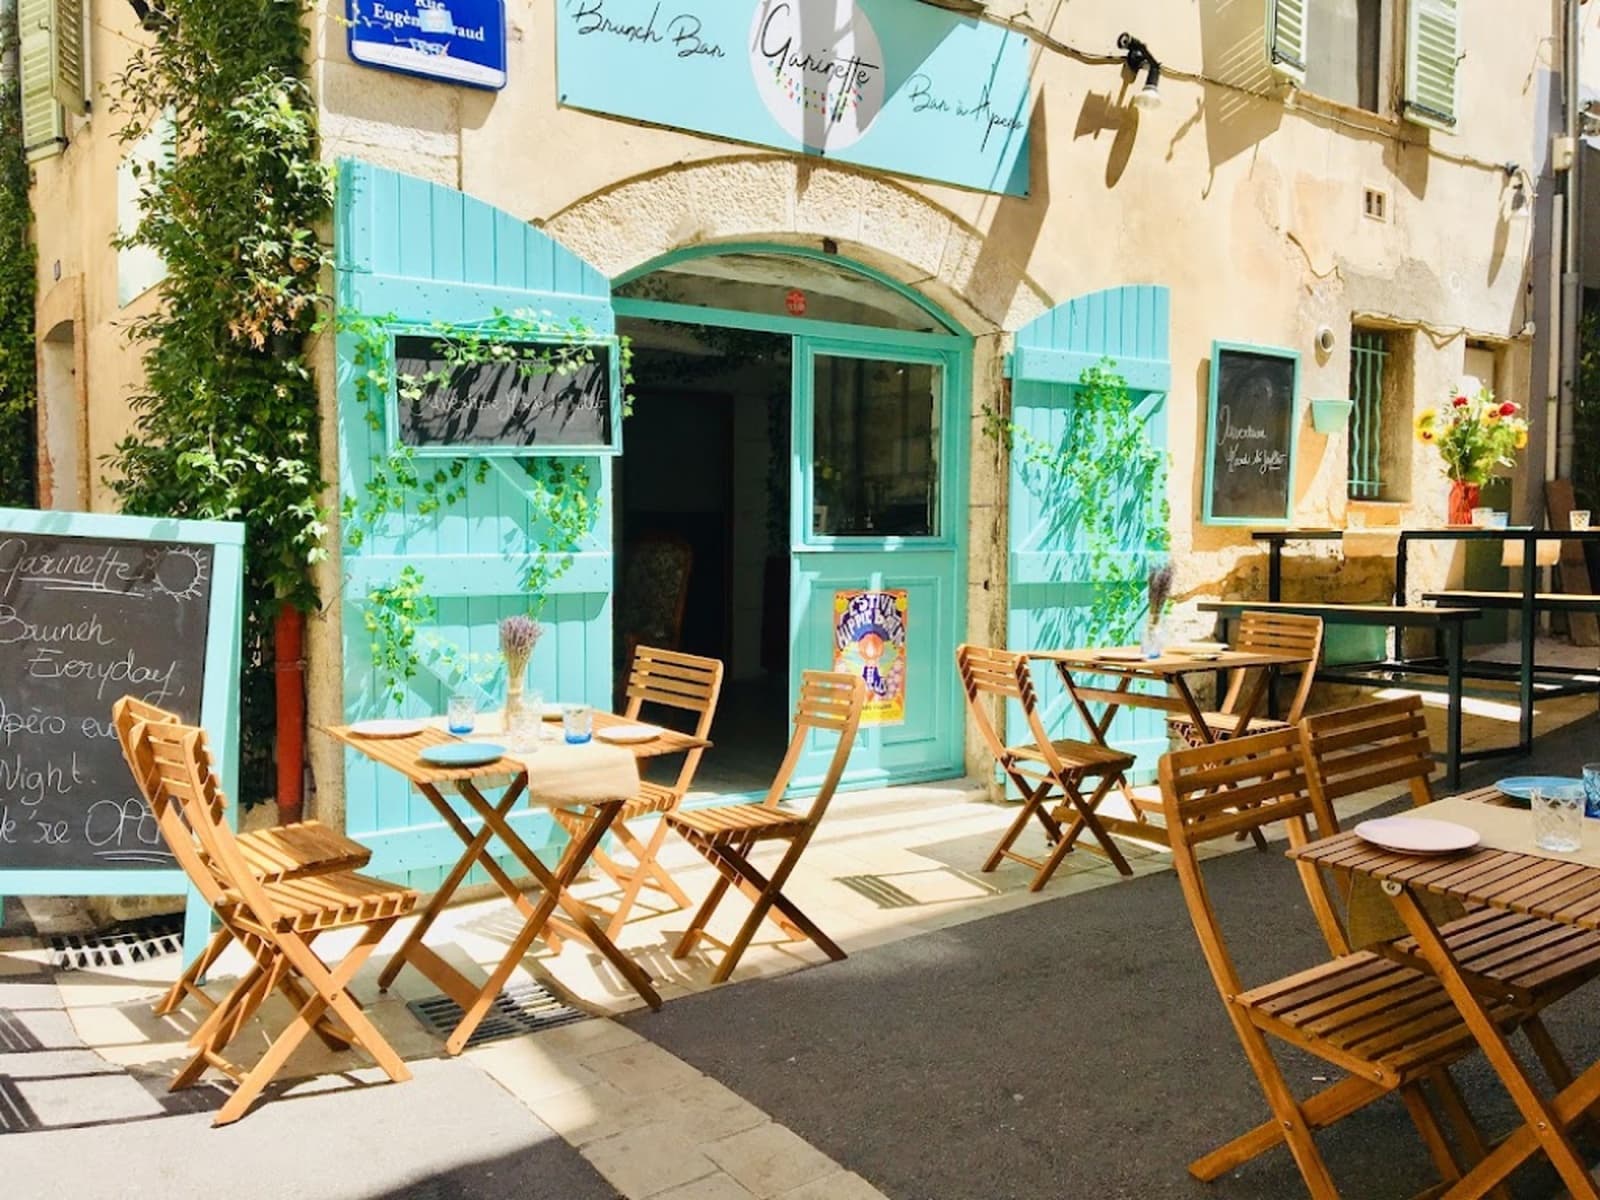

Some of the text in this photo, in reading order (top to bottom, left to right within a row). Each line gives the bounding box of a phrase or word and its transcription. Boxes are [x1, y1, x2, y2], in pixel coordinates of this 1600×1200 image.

[373, 3, 421, 27] Eugèn
[572, 0, 726, 58] Brunch Bar
[761, 3, 880, 123] Garinette
[906, 73, 950, 113] Bar
